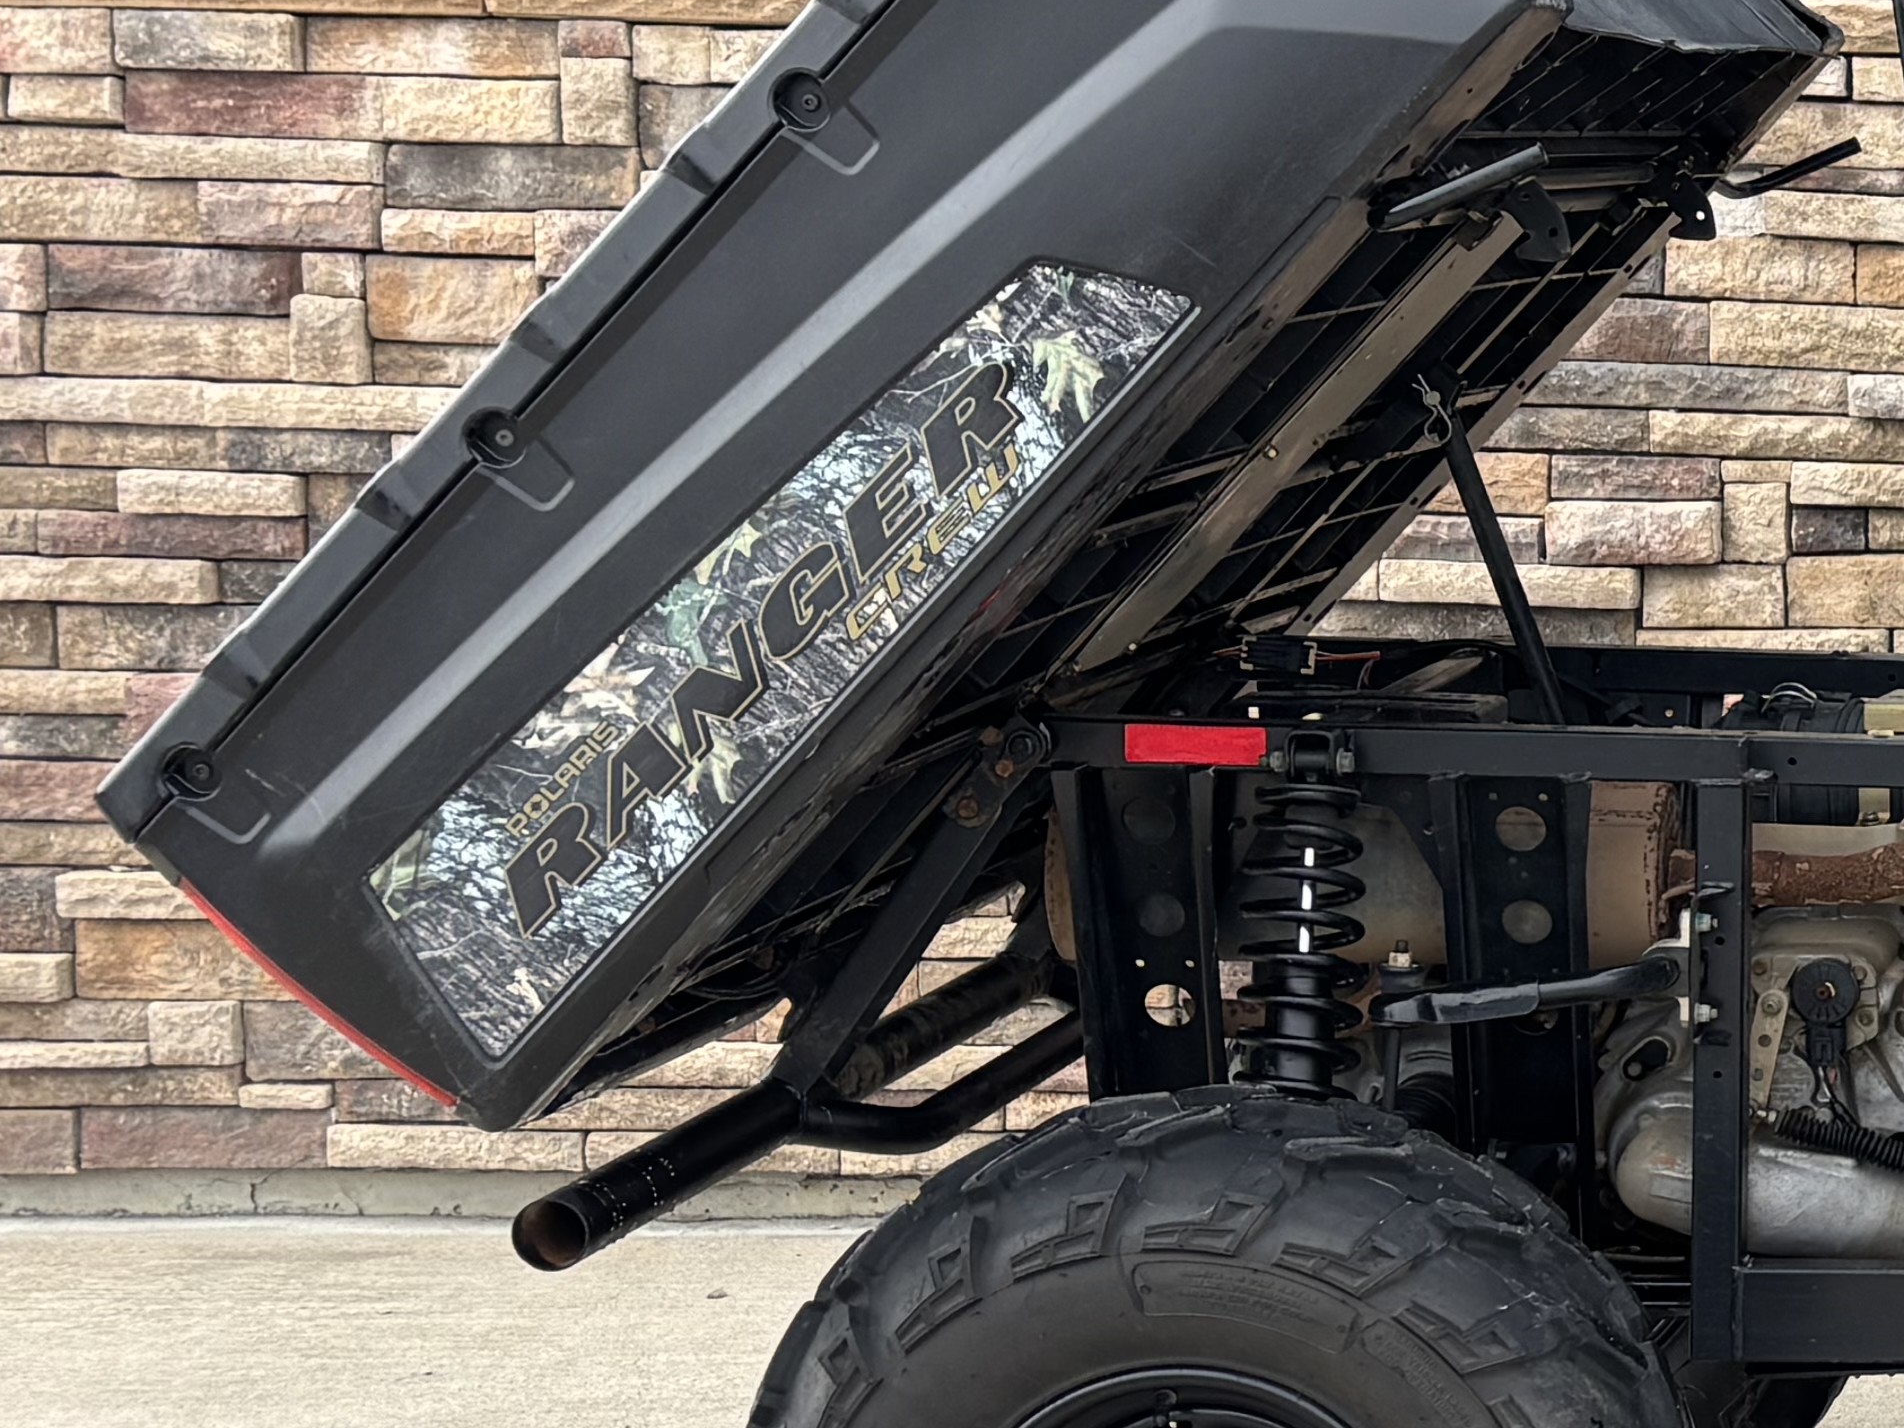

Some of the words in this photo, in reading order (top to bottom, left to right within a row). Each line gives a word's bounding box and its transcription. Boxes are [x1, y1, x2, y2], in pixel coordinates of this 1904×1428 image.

[845, 443, 1019, 641] CREW
[503, 362, 1021, 939] RANGER
[504, 720, 620, 838] POLARIS
